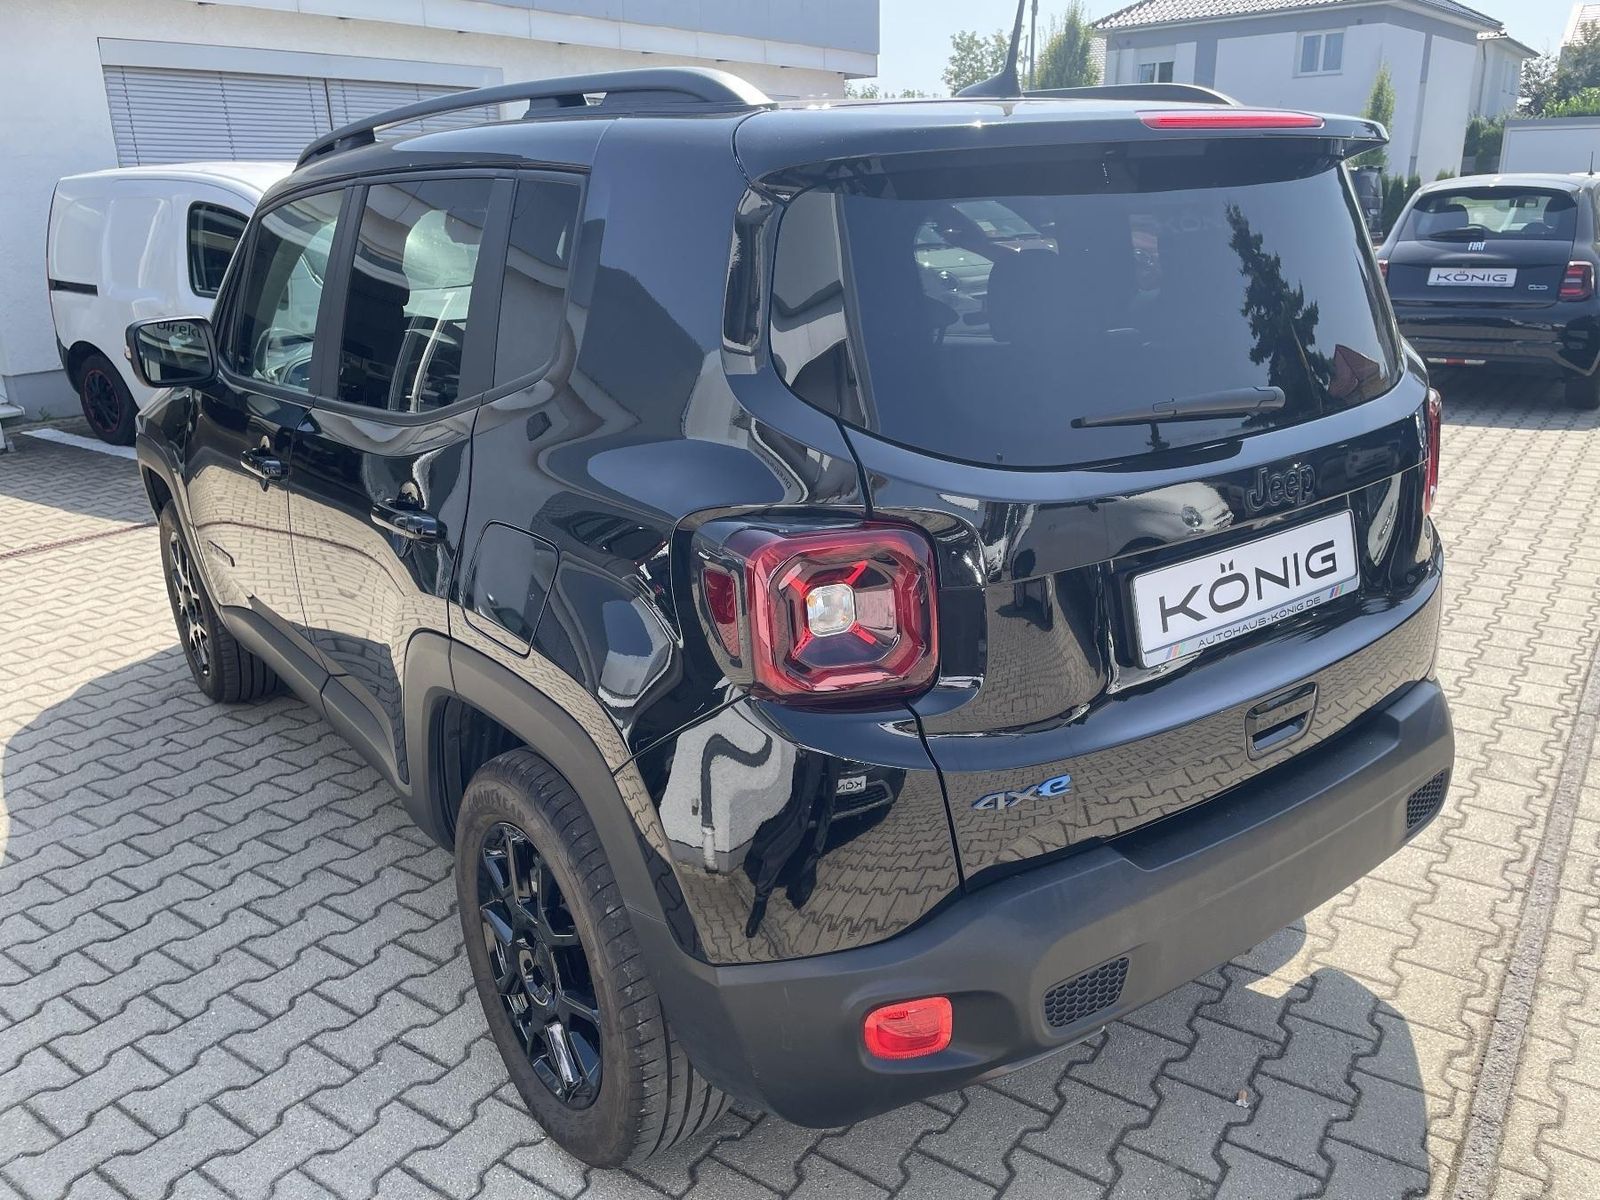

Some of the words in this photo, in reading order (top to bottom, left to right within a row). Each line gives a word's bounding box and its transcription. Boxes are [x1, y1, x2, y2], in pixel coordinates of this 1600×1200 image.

[1468, 242, 1486, 250] FIAT
[1436, 270, 1508, 282] KÖNIG
[1248, 464, 1315, 511] Jeep
[1158, 540, 1338, 634] KÖNIG
